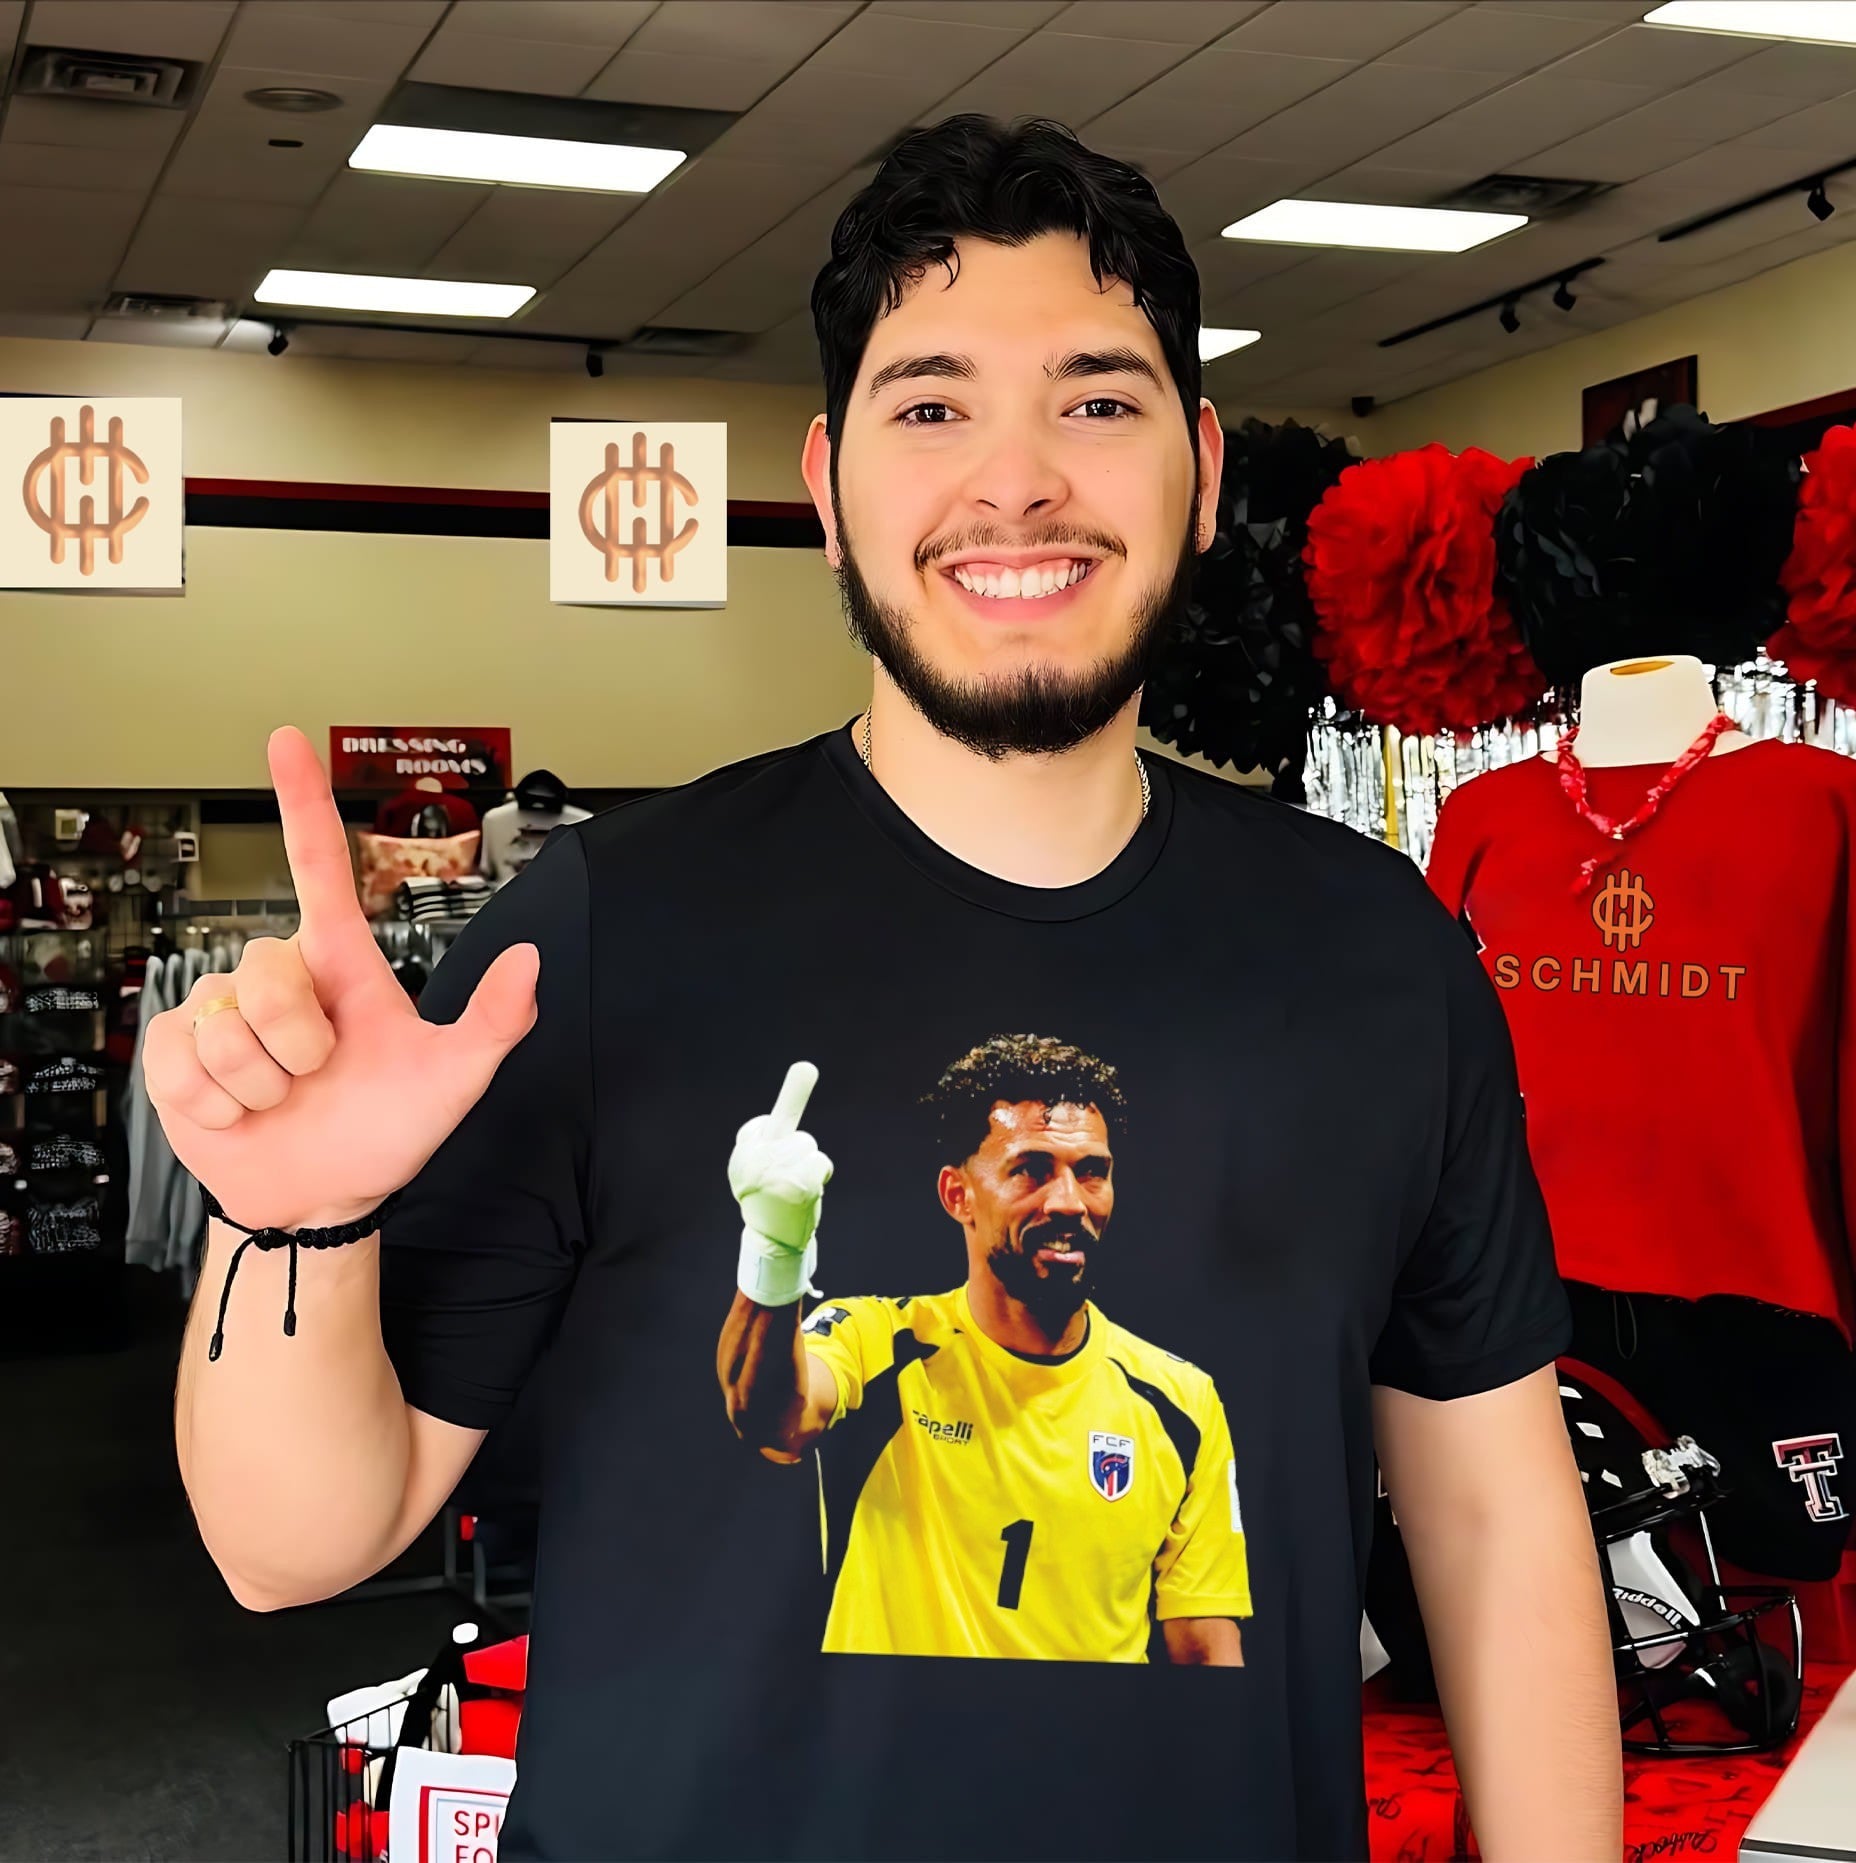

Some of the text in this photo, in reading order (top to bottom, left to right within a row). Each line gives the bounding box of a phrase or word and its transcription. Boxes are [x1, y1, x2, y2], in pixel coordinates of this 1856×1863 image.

[396, 758, 487, 775] ROOMS
[1494, 955, 1746, 1000] SCHMIDT
[1093, 1434, 1131, 1448] FCF
[997, 1518, 1034, 1611] 1
